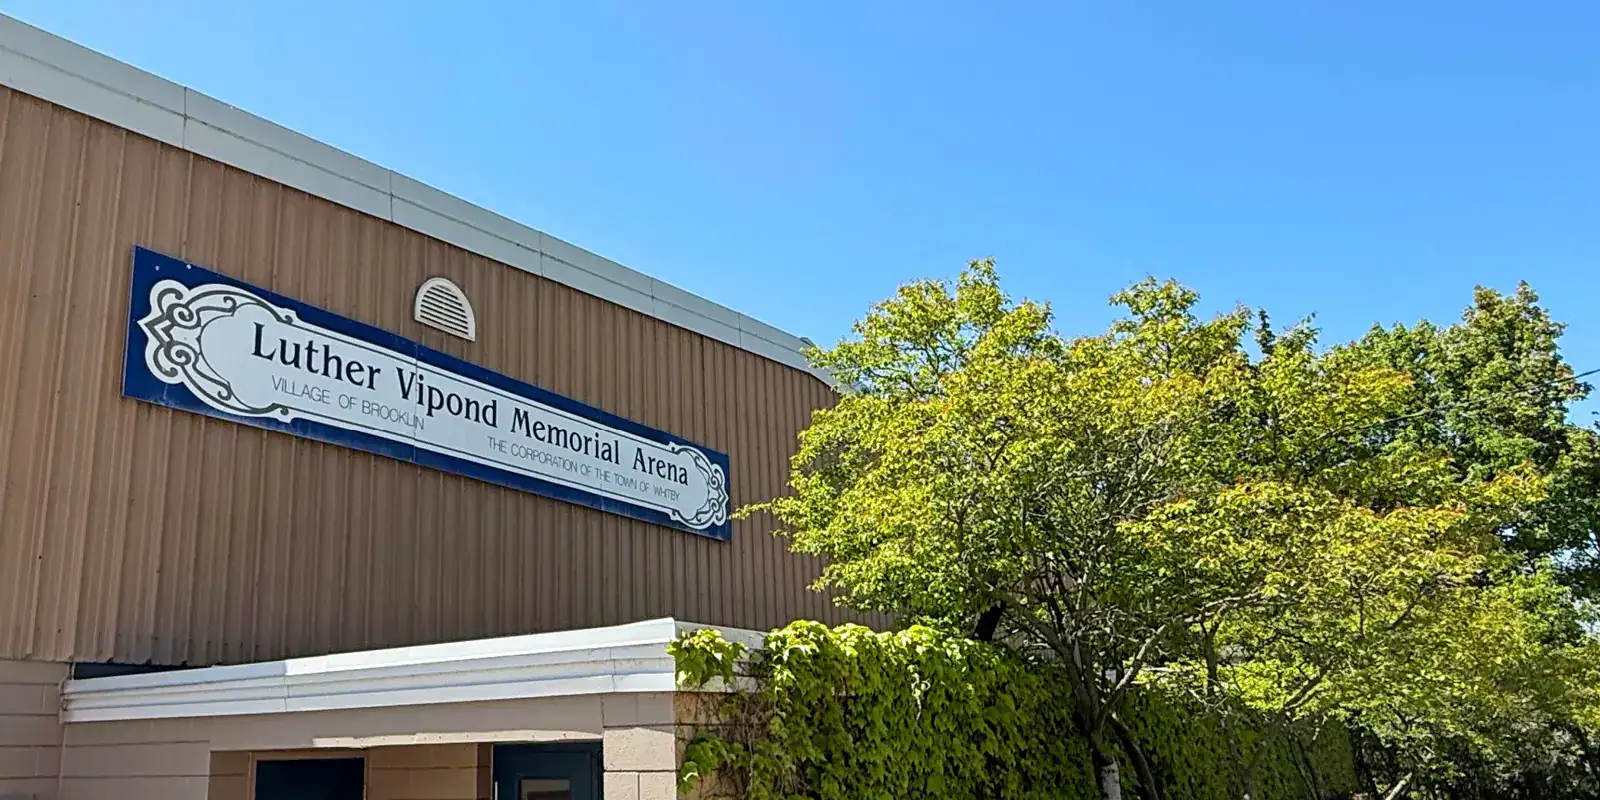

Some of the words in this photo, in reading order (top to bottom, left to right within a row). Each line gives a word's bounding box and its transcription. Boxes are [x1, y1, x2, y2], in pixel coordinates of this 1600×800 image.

[251, 321, 381, 391] Luther
[396, 366, 498, 428] Vipond
[510, 407, 620, 466] Memorial
[632, 447, 689, 486] Arena
[271, 375, 330, 405] VILLAGE
[338, 393, 357, 409] OF
[362, 400, 425, 431] BROOKLIN
[488, 435, 507, 452] THE
[511, 443, 578, 473] CORPORATION
[580, 463, 592, 476] OF
[595, 467, 611, 483] THE
[613, 473, 638, 490] TOWN
[639, 480, 650, 493] OF
[653, 484, 680, 501] WHITBY
